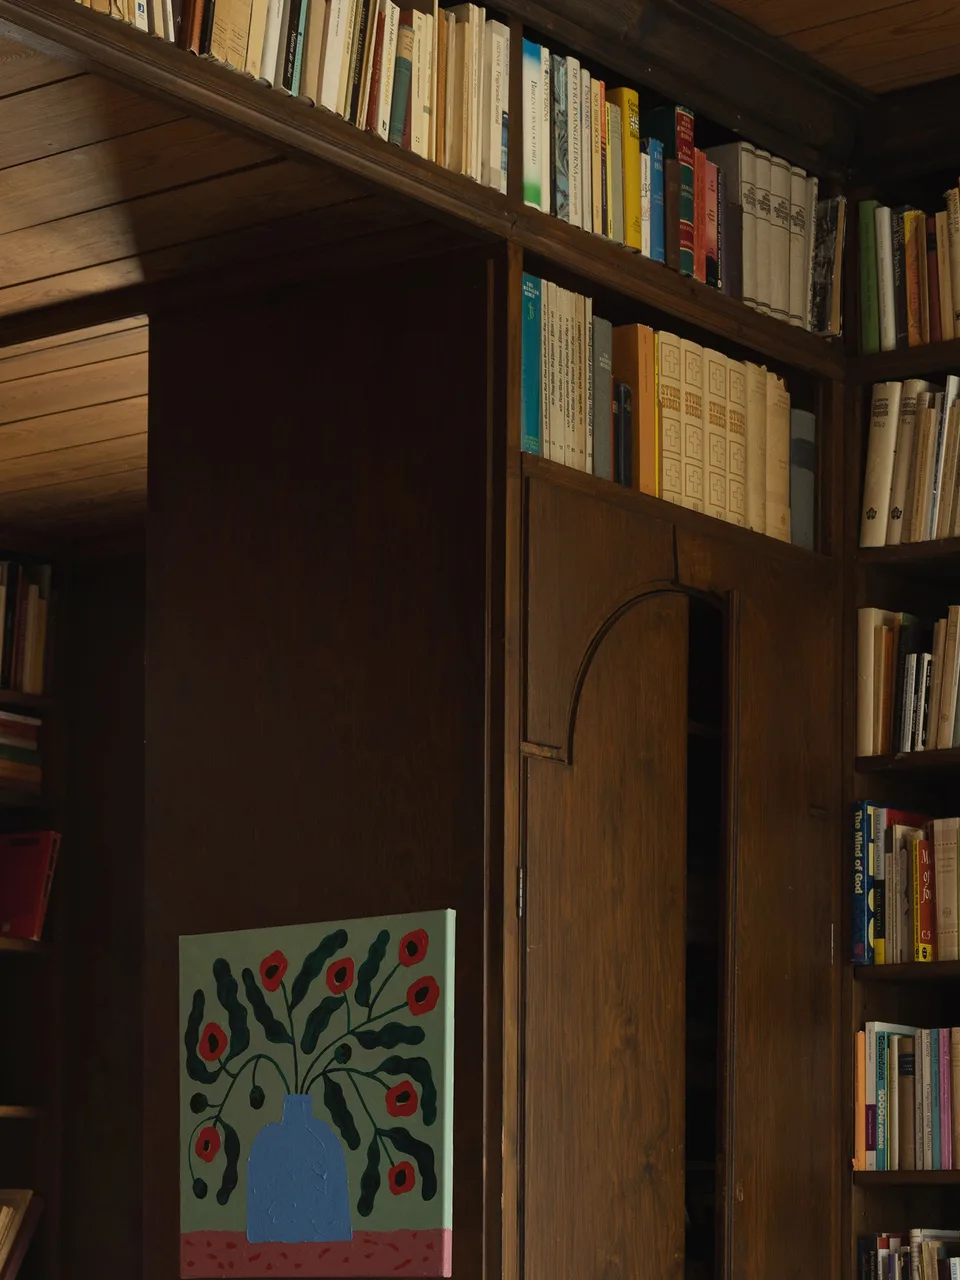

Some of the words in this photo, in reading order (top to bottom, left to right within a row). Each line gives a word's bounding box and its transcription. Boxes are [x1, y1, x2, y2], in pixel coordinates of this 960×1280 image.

[289, 30, 297, 52] Natten
[572, 68, 577, 79] DE
[854, 810, 863, 828] The
[854, 832, 863, 857] Mind
[855, 860, 863, 868] of
[854, 872, 863, 894] God
